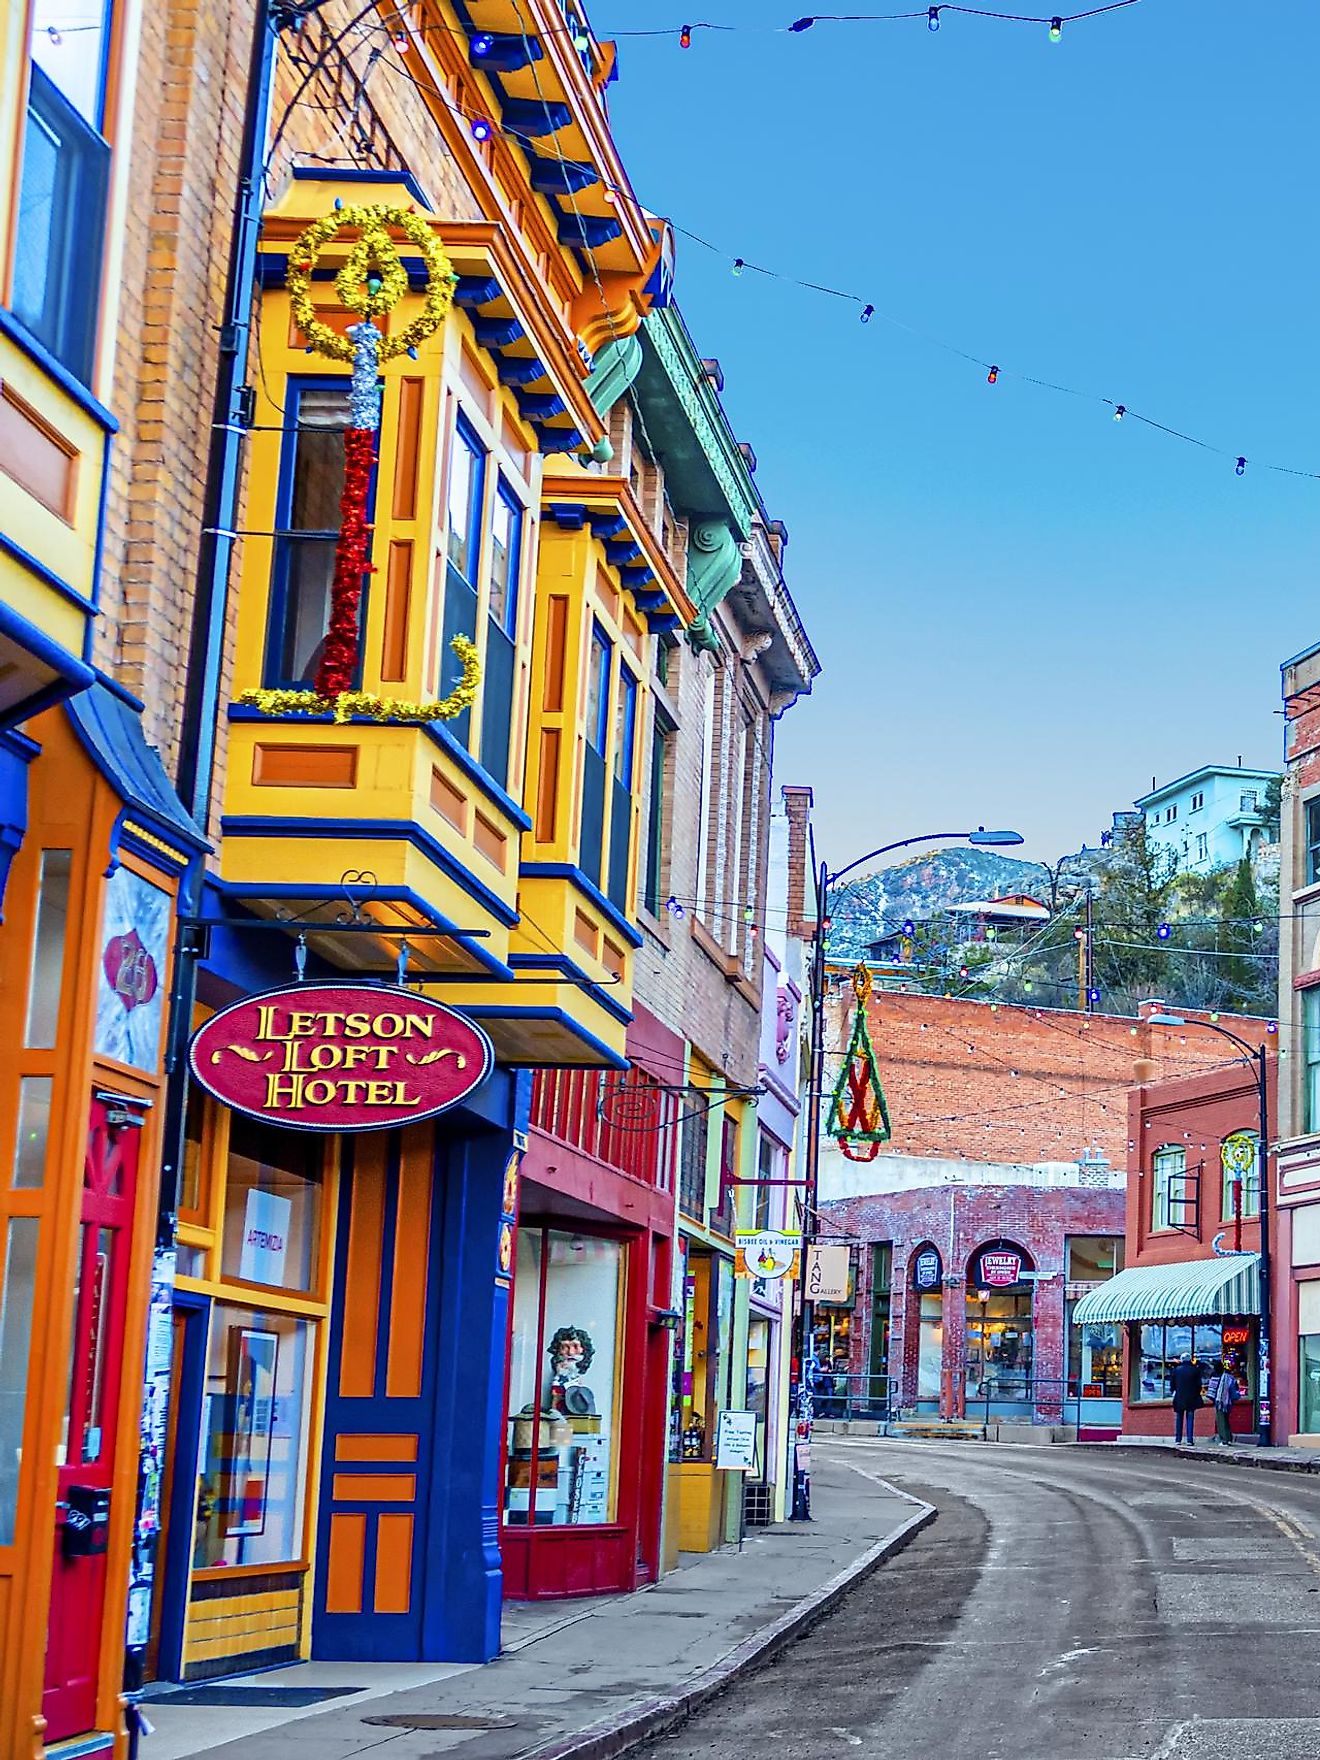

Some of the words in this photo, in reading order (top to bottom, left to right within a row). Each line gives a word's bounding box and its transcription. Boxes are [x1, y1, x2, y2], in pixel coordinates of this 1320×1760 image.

[255, 1006, 436, 1040] LETSON
[281, 1041, 398, 1072] LOFT
[262, 1074, 421, 1108] HOTEL
[809, 1250, 823, 1294] TANG
[985, 1256, 1016, 1266] JEWELRY
[1223, 1331, 1248, 1343] OPEN
